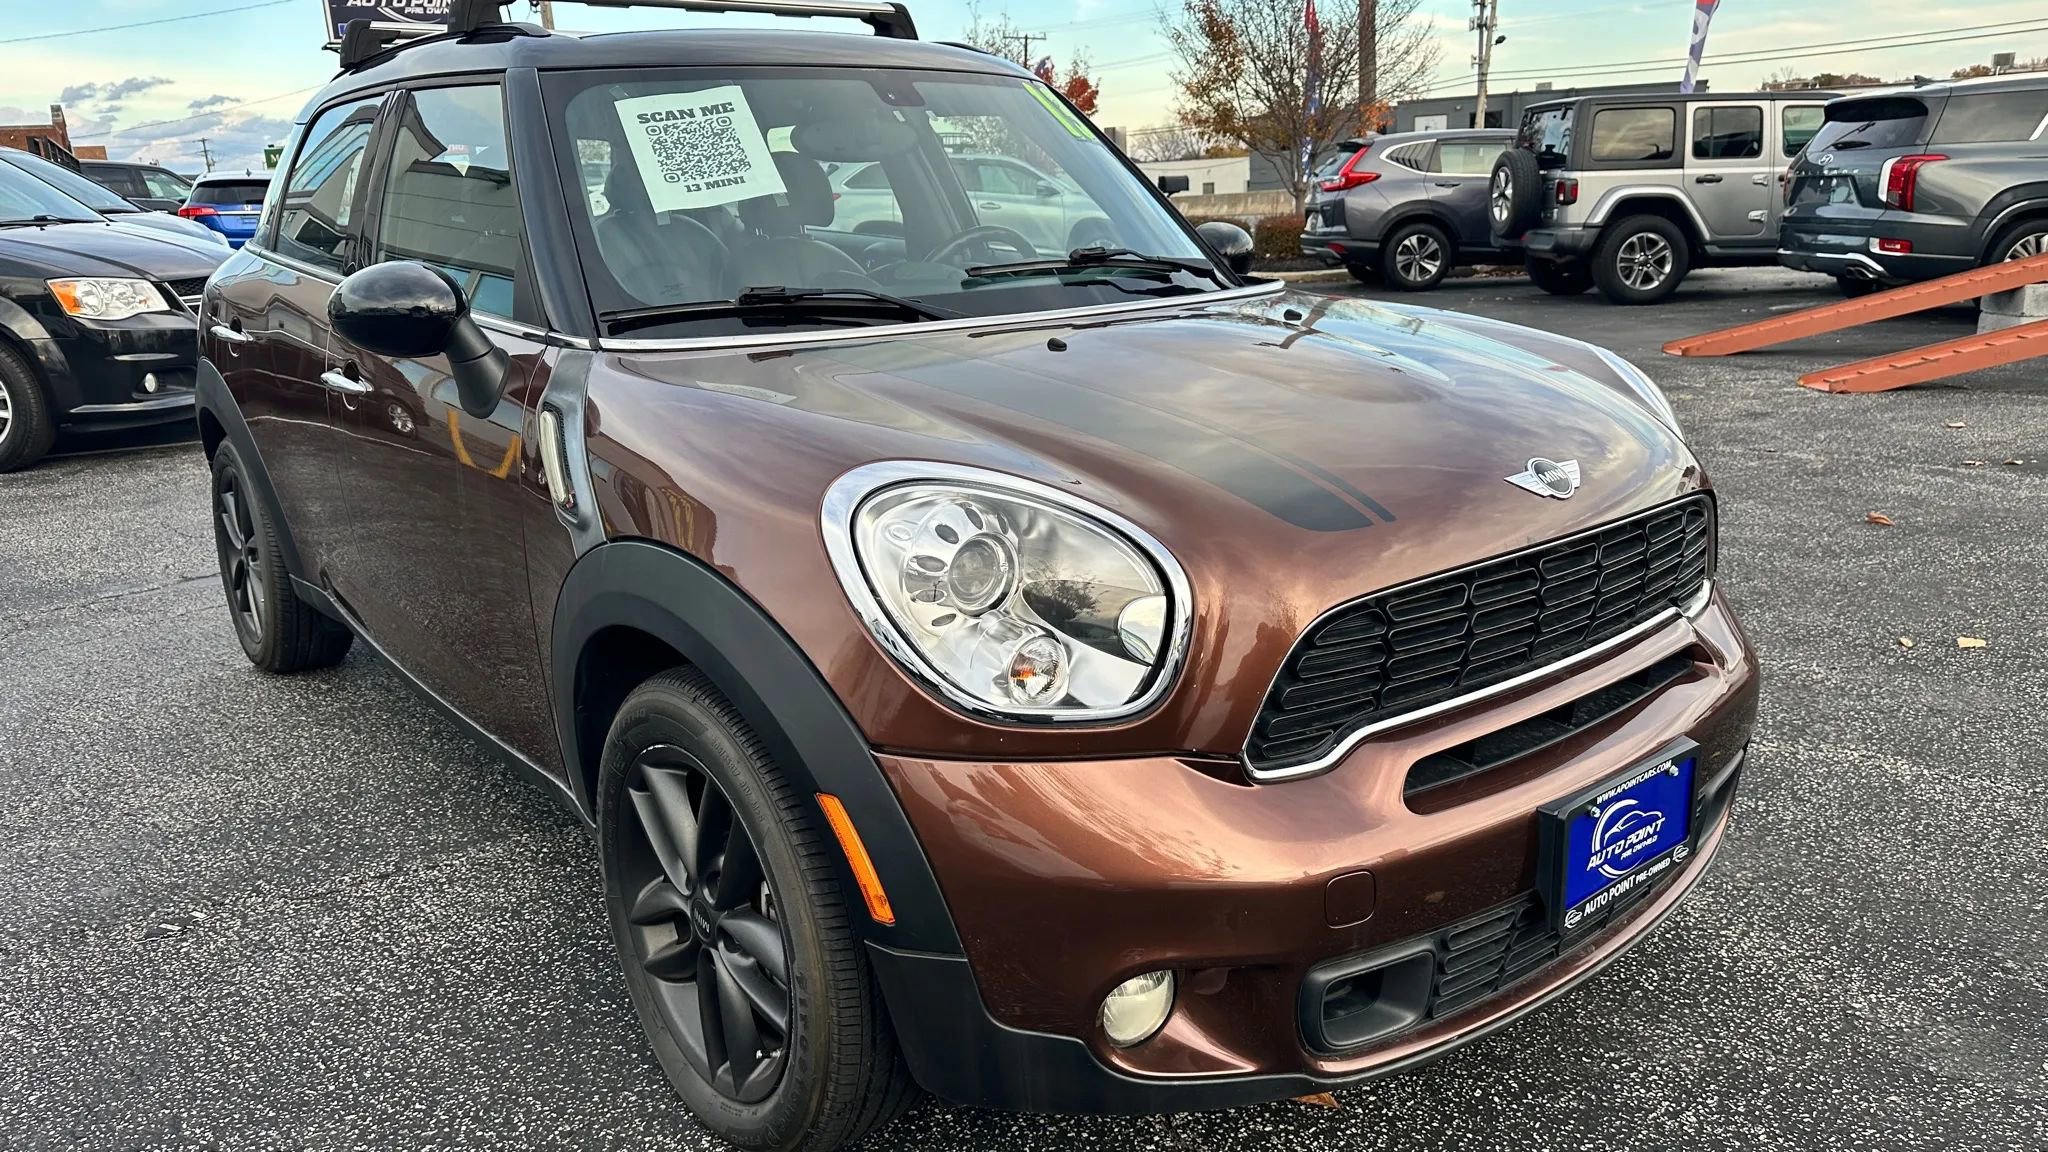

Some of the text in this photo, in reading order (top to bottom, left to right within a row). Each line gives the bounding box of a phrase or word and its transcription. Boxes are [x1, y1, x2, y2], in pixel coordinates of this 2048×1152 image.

[637, 102, 735, 124] SCAN ME
[684, 176, 745, 193] 13 MINI
[1538, 468, 1567, 484] MINI
[1596, 760, 1672, 804] WWW.APOINTCARS.COM
[1586, 817, 1666, 871] AUTO POINT
[1584, 857, 1671, 916] AUTO POINT PRE-OWNED
